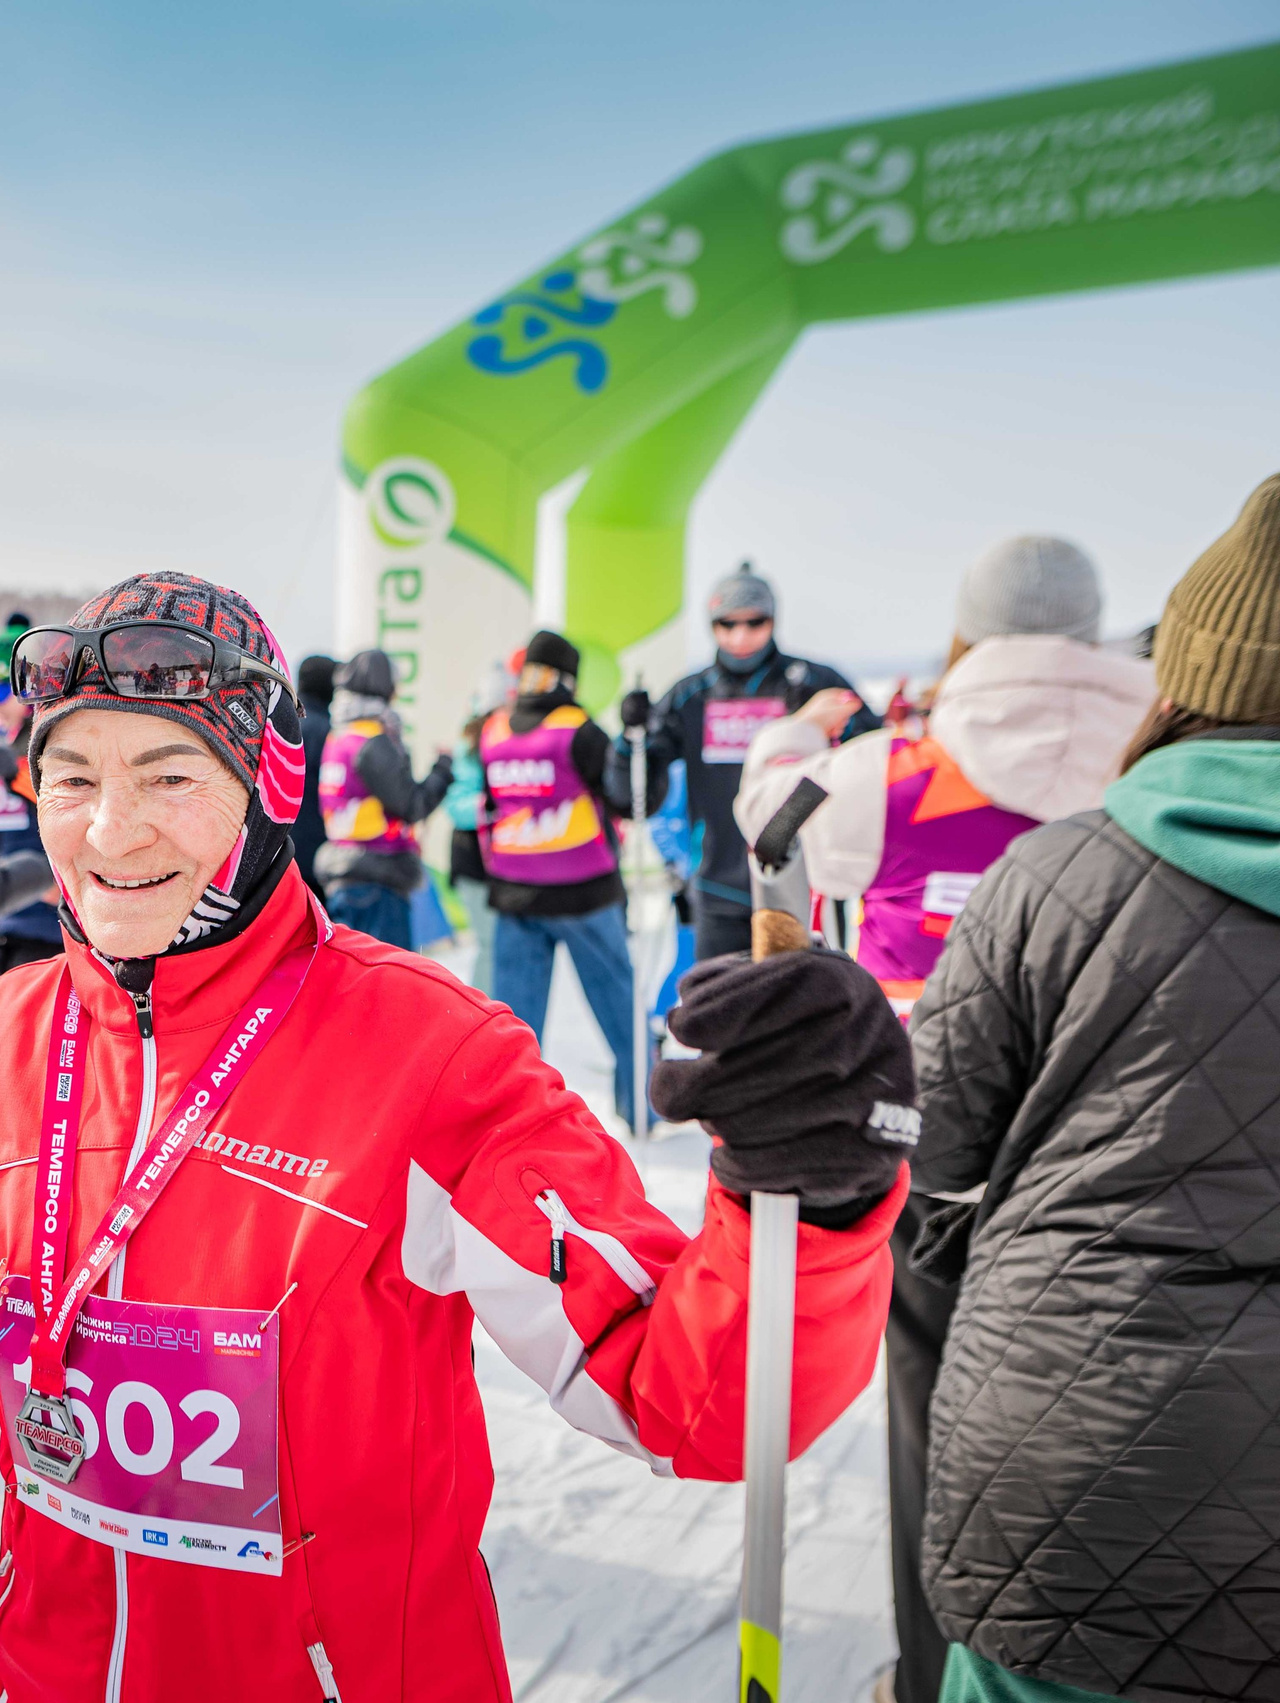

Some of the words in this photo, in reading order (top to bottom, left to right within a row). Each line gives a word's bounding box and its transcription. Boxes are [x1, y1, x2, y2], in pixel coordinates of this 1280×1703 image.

[65, 1040, 76, 1068] БАМ
[210, 1007, 273, 1088] АНГАРА
[136, 1090, 210, 1191] ТЕМЕРСО
[44, 1119, 67, 1234] ТЕМЕРСО
[89, 1235, 111, 1264] БАМ
[76, 1311, 112, 1330] Лыжня
[76, 1322, 127, 1344] Иркутска
[213, 1332, 262, 1349] БАМ
[16, 1419, 81, 1455] ТЕМЕРСО
[33, 1463, 64, 1478] ИРКУТСКА
